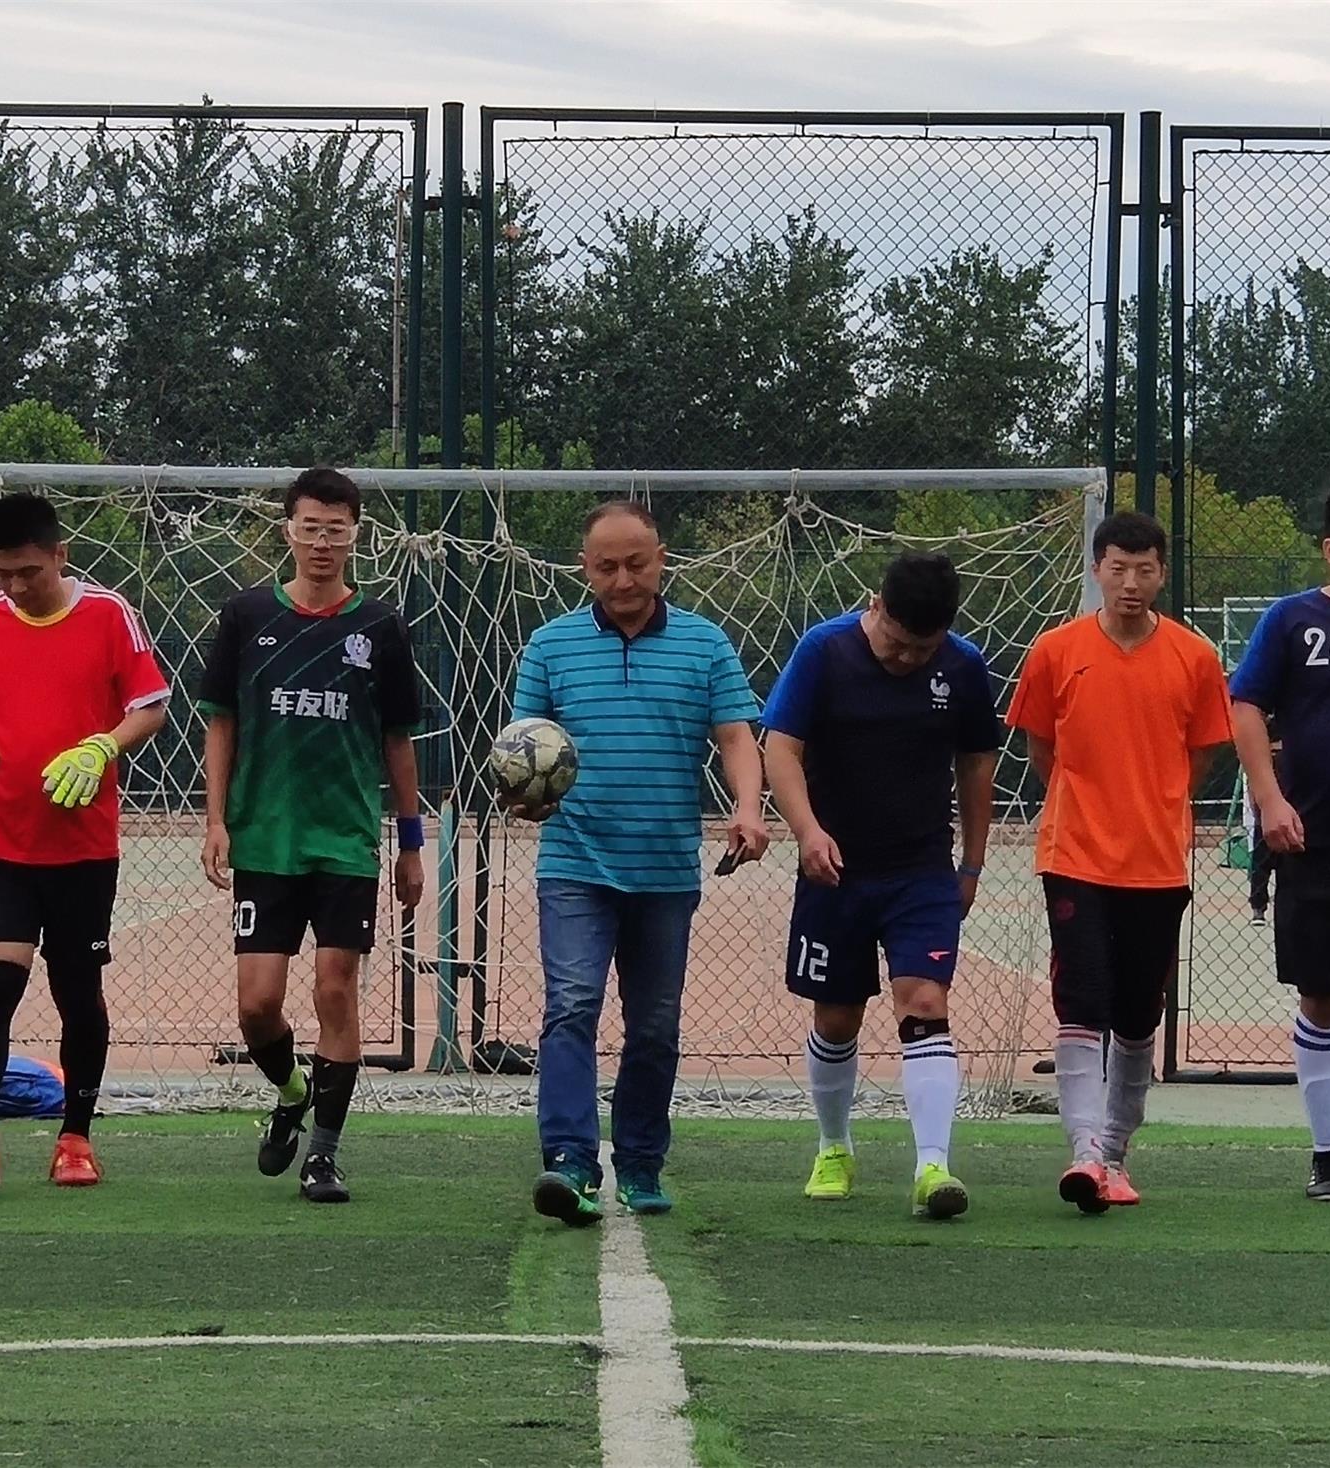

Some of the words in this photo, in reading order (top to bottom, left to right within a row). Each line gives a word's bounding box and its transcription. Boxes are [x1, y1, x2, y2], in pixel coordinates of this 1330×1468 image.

[270, 686, 350, 721] 车友联
[233, 900, 257, 937] 0
[796, 935, 830, 983] 12
